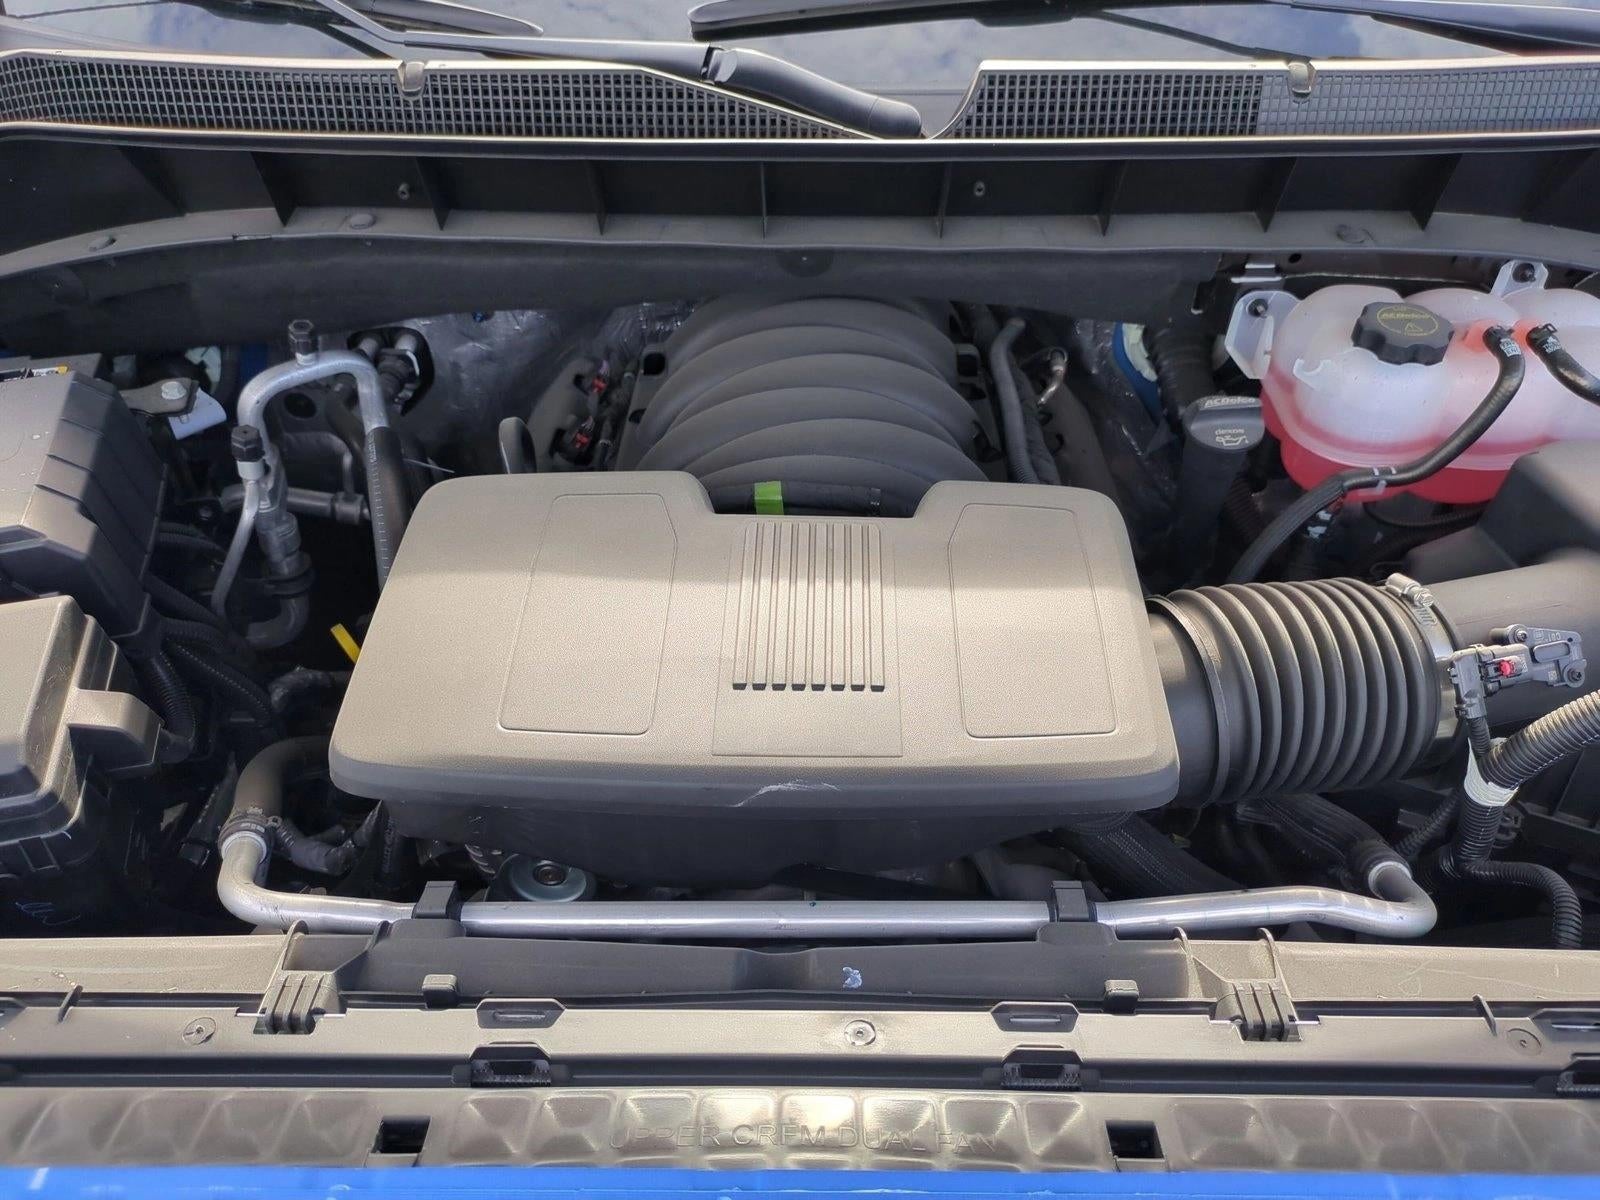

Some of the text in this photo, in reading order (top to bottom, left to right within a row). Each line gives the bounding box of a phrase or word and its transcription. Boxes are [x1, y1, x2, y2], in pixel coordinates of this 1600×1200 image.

[609, 1125, 721, 1149] UPPER
[838, 1126, 927, 1151] DUAL
[935, 1130, 997, 1154] FAN
